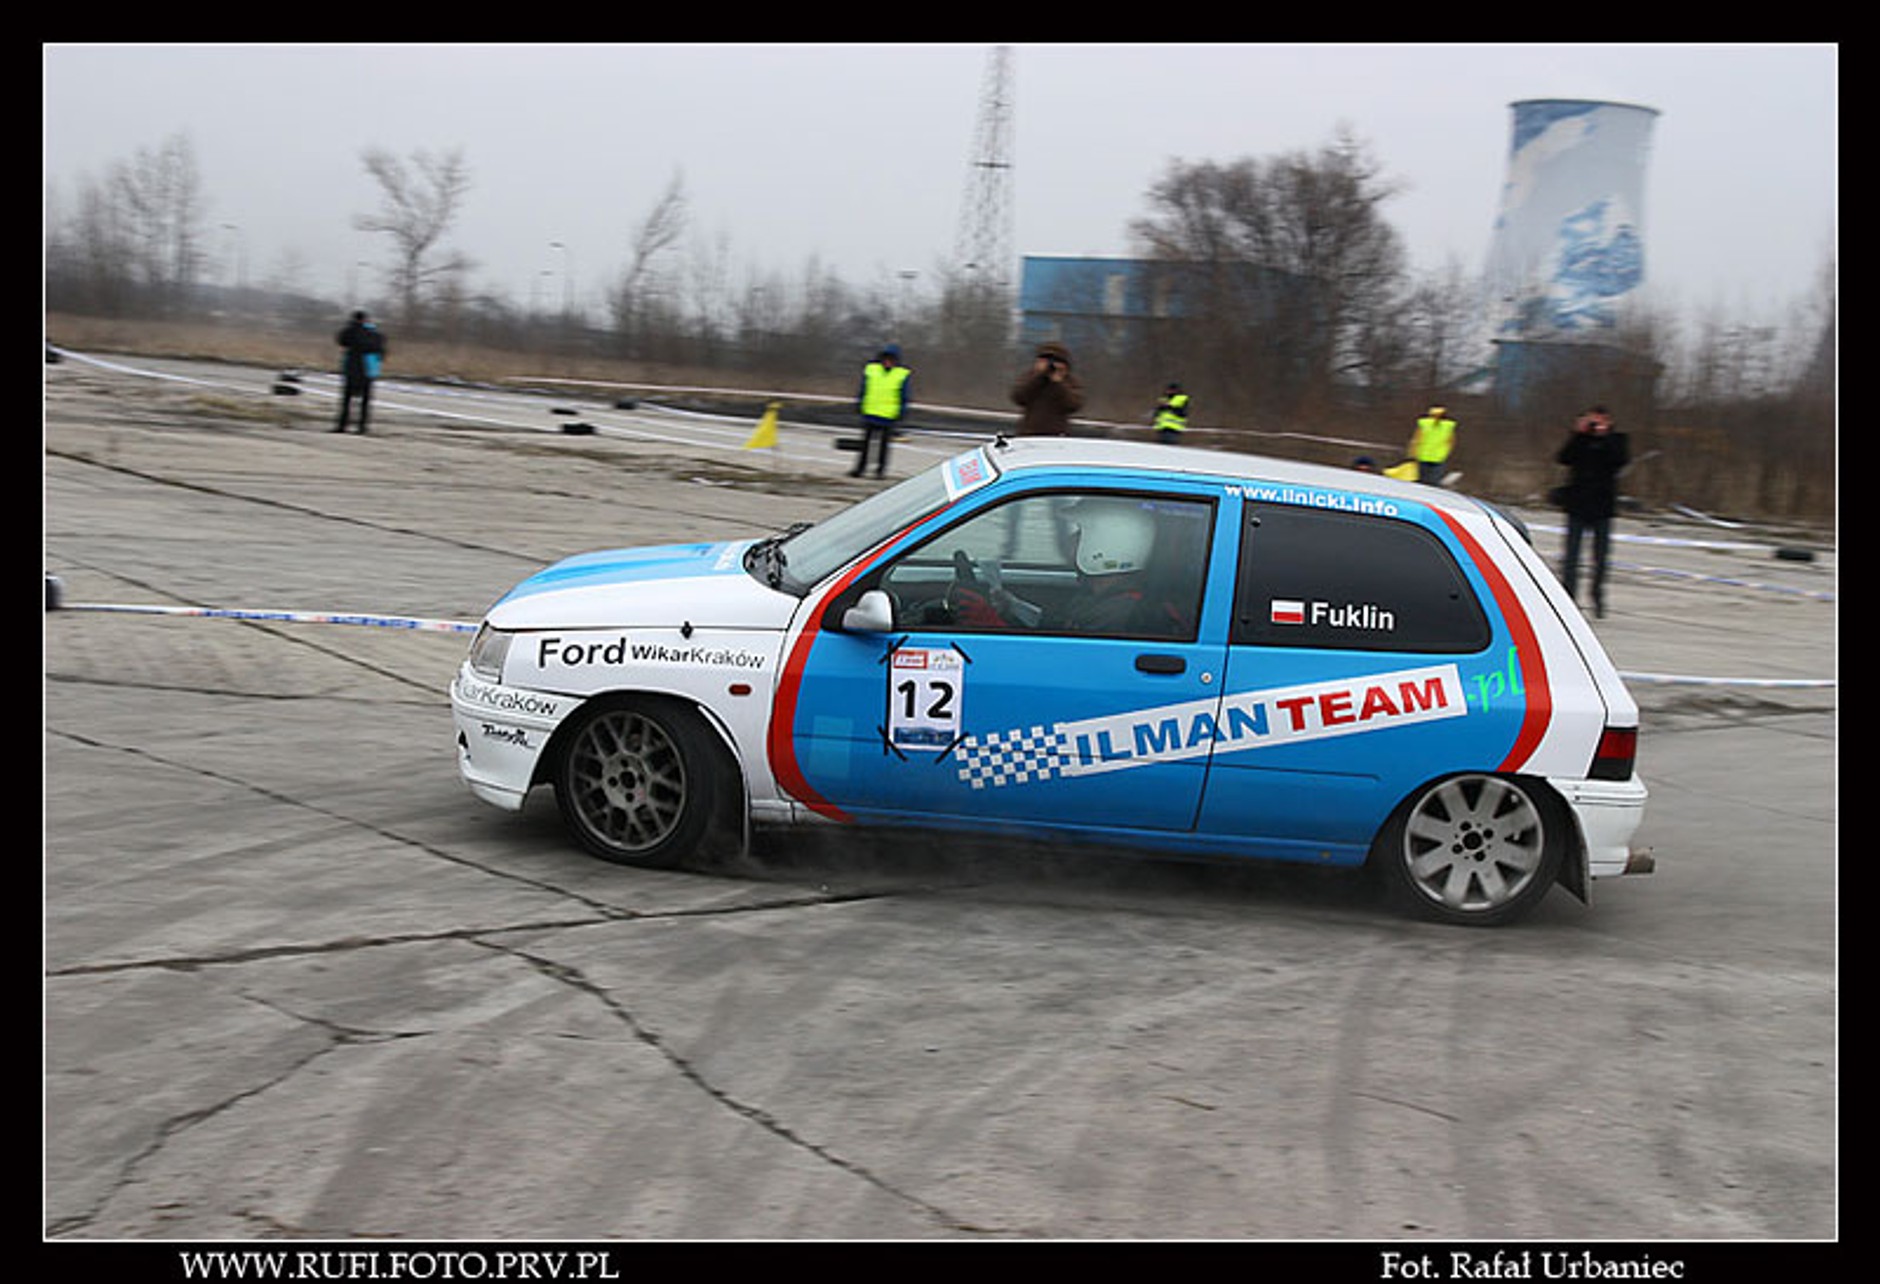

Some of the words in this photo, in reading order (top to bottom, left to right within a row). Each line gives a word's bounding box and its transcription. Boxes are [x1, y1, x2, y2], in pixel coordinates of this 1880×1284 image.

[1224, 484, 1398, 516] www.linicki.info
[1311, 602, 1395, 631] Fuklin
[538, 637, 627, 669] Ford
[897, 680, 953, 719] 12
[1076, 703, 1270, 767] ILMAN
[1276, 677, 1449, 732] TEAM
